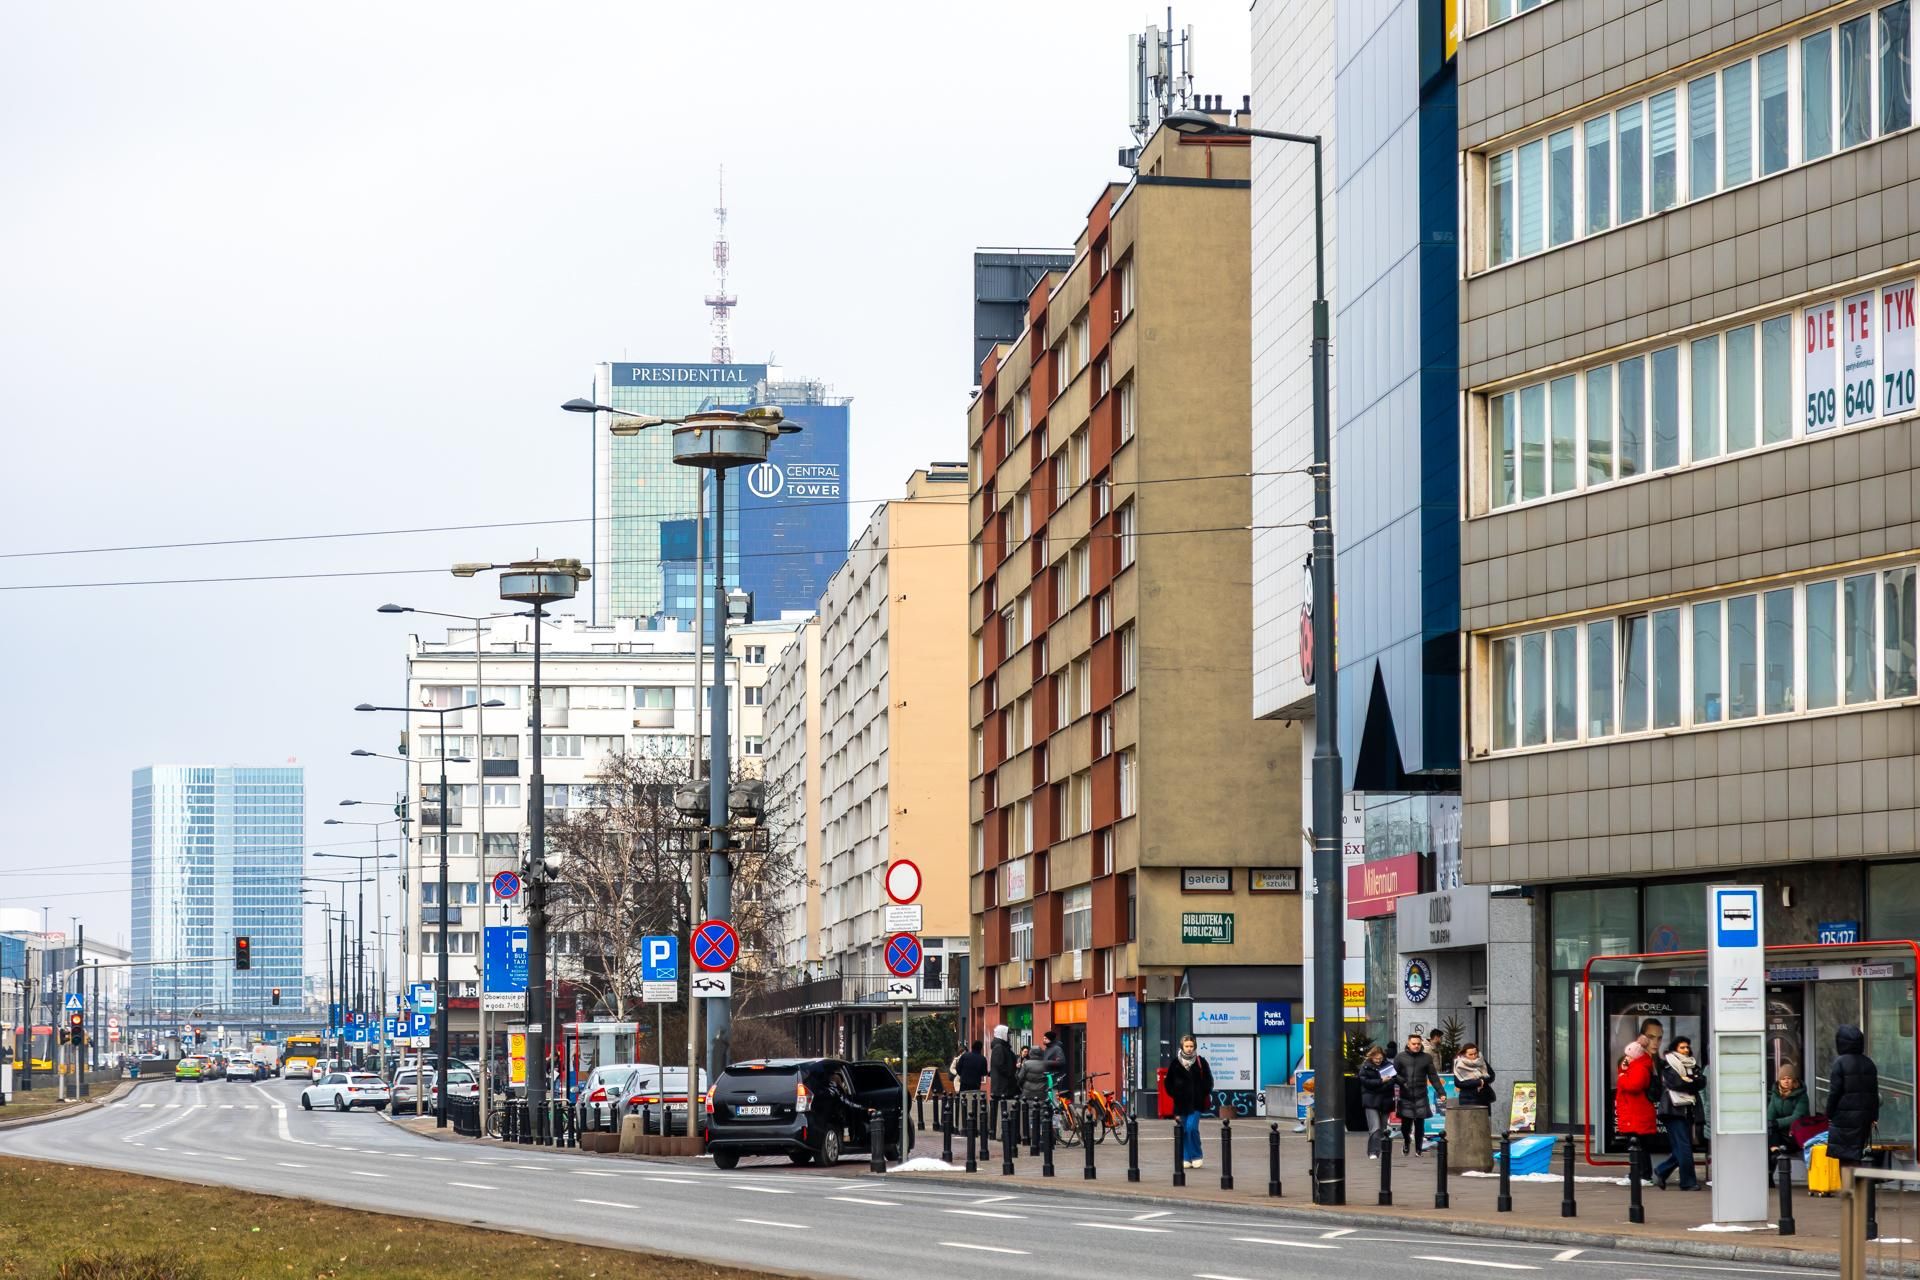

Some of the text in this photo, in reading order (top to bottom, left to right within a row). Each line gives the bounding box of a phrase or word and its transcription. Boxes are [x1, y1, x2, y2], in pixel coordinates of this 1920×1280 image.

[1807, 287, 1916, 354] DIE TE TYK
[631, 367, 748, 382] PRESIDENTIAL
[1808, 368, 1915, 427] 509 640 710
[787, 466, 840, 477] CENTRAL
[787, 485, 840, 496] TOWER
[1188, 874, 1226, 885] galeria
[1363, 864, 1398, 897] Millennium
[1183, 914, 1223, 925] BIBLIOTEKA
[1183, 926, 1223, 937] PUBLICZNA
[650, 941, 670, 968] P
[414, 1014, 426, 1030] P
[1209, 1013, 1228, 1021] ALAB
[397, 1022, 408, 1036] P
